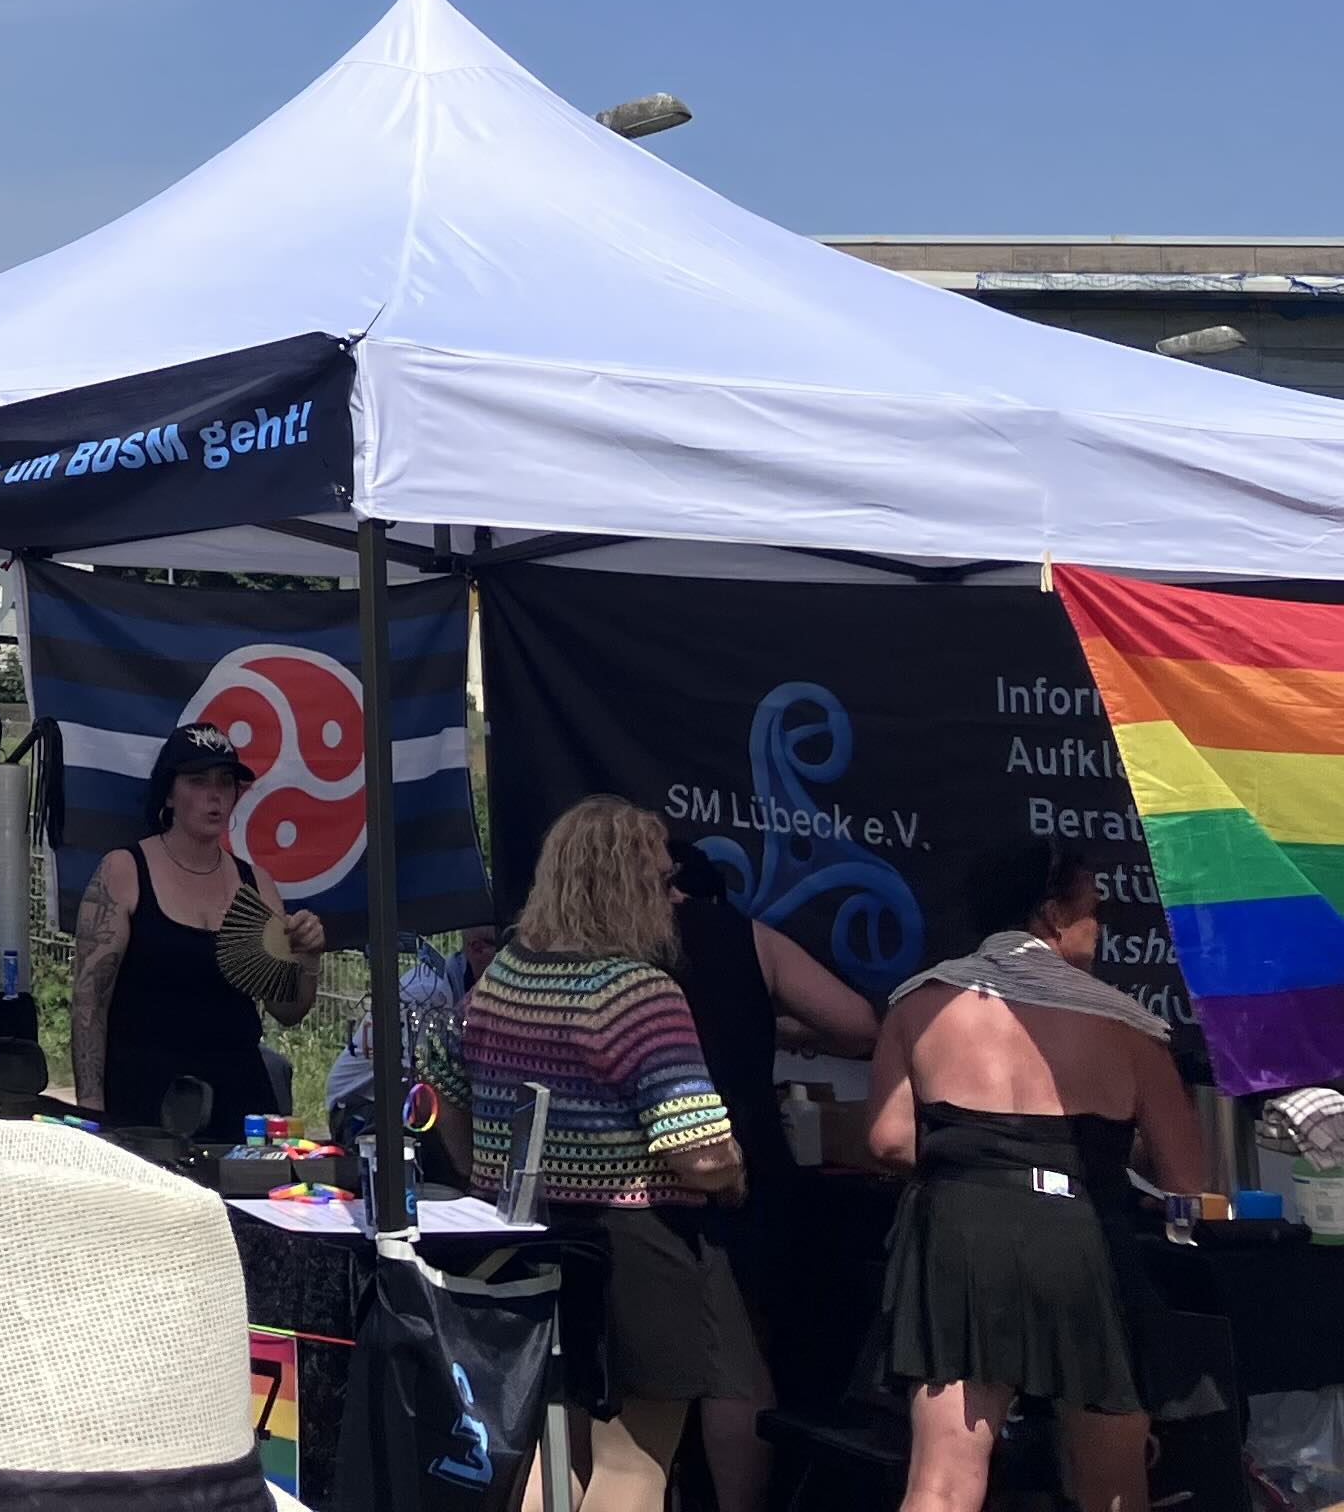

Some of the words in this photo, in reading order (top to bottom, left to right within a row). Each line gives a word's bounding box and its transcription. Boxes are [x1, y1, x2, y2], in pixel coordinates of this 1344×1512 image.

[4, 452, 60, 484] um
[64, 423, 188, 478] BDSM
[199, 400, 313, 470] geht!
[664, 784, 720, 824] SM
[731, 792, 853, 840] Lübeck
[864, 810, 932, 851] e.V.
